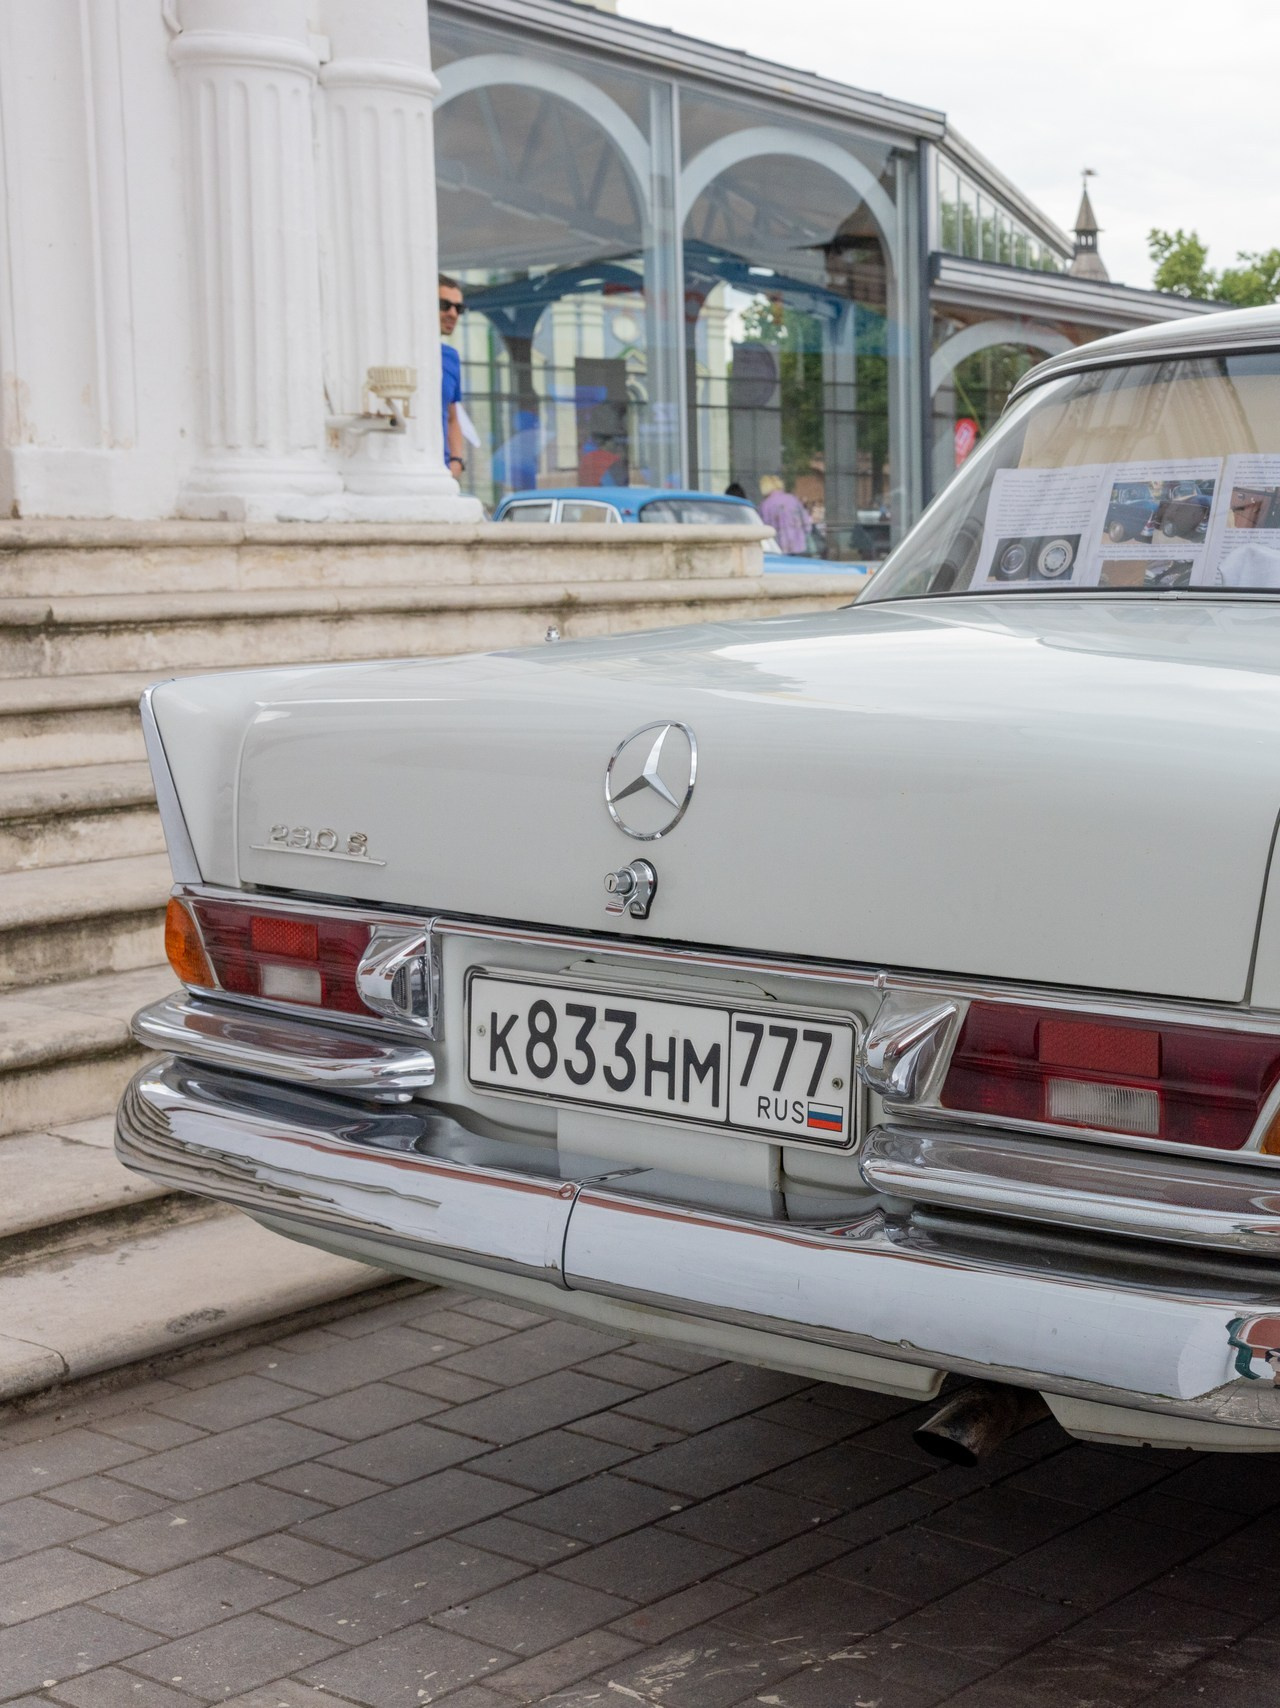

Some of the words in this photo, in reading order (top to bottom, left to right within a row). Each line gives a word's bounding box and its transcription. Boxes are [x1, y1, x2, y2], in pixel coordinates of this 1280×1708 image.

[269, 823, 339, 852] 230
[347, 832, 368, 857] S
[489, 999, 721, 1108] К833НМ
[735, 1020, 833, 1098] 777
[757, 1095, 805, 1124] RUS
